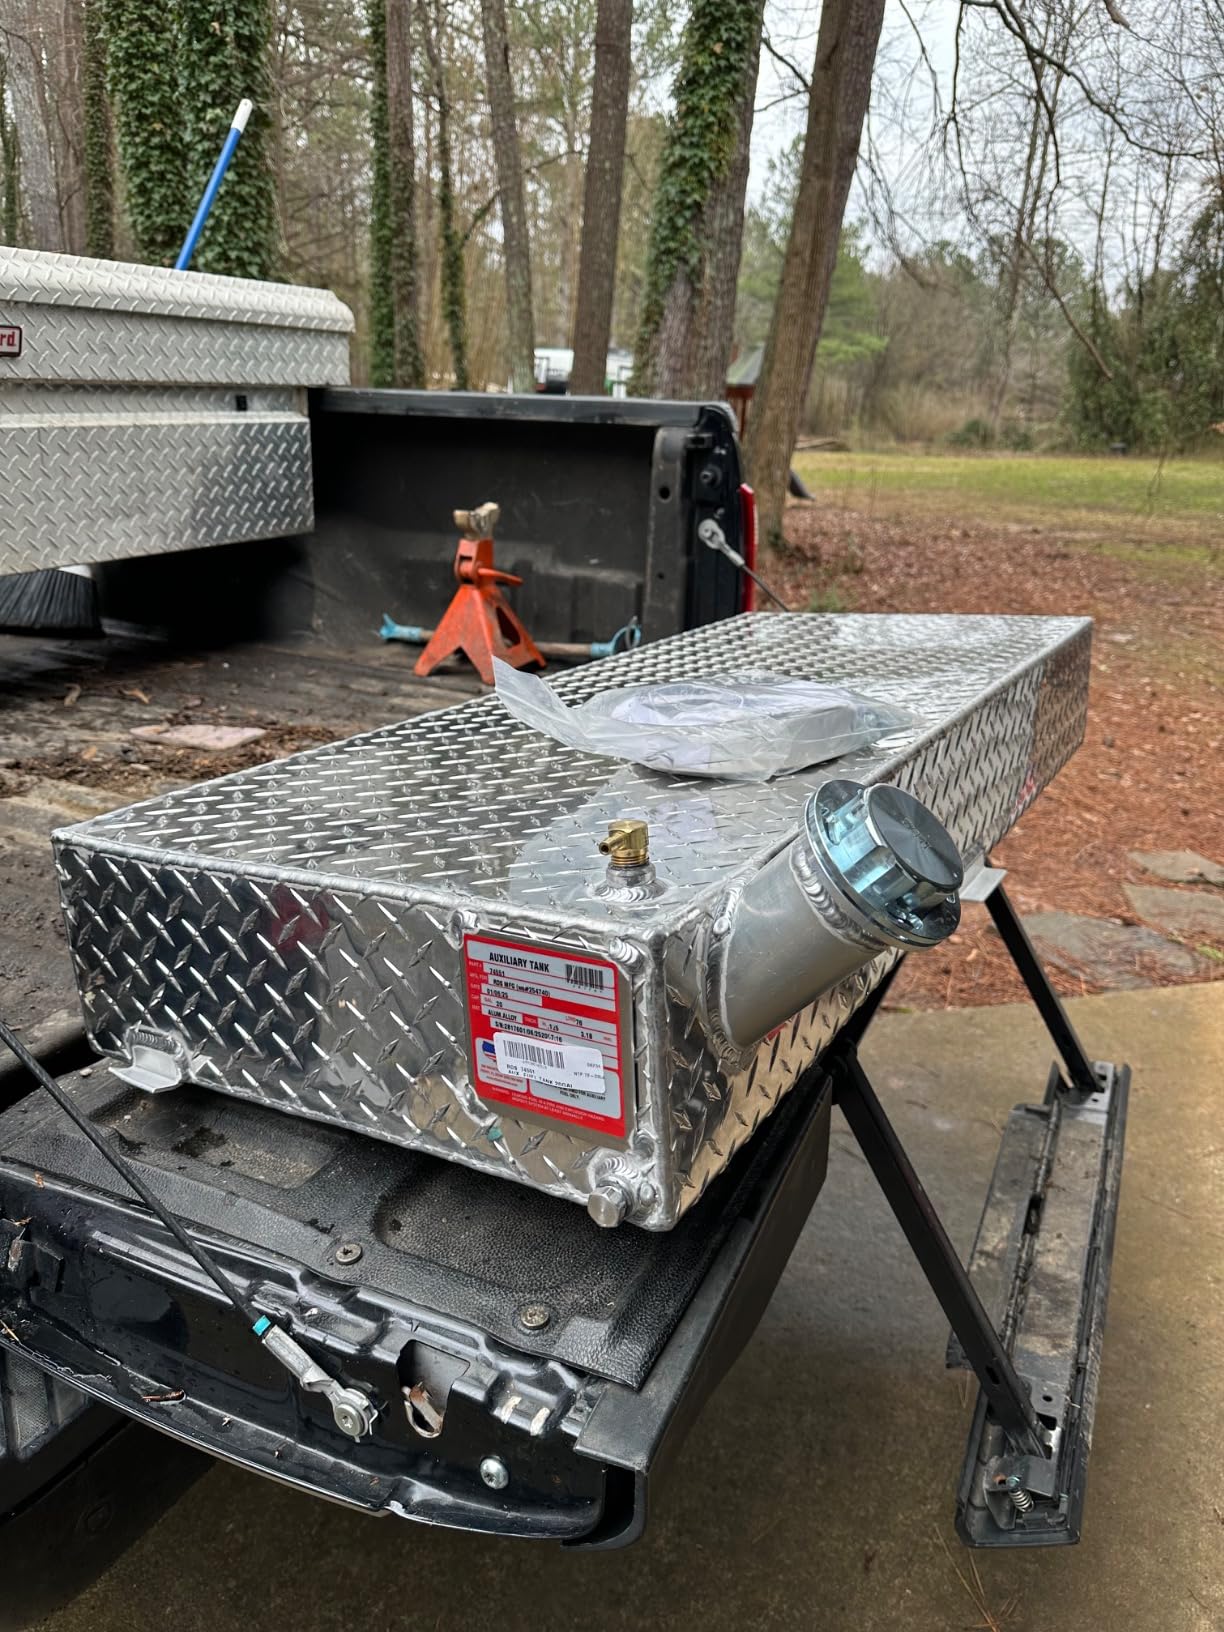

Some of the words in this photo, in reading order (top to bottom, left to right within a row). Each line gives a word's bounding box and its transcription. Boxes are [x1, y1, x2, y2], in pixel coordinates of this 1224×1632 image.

[489, 952, 527, 968] AUXILIARY
[530, 960, 550, 973] TANK
[504, 981, 515, 990] MFG
[487, 1009, 502, 1018] ALUM
[502, 1011, 517, 1021] ALLOY
